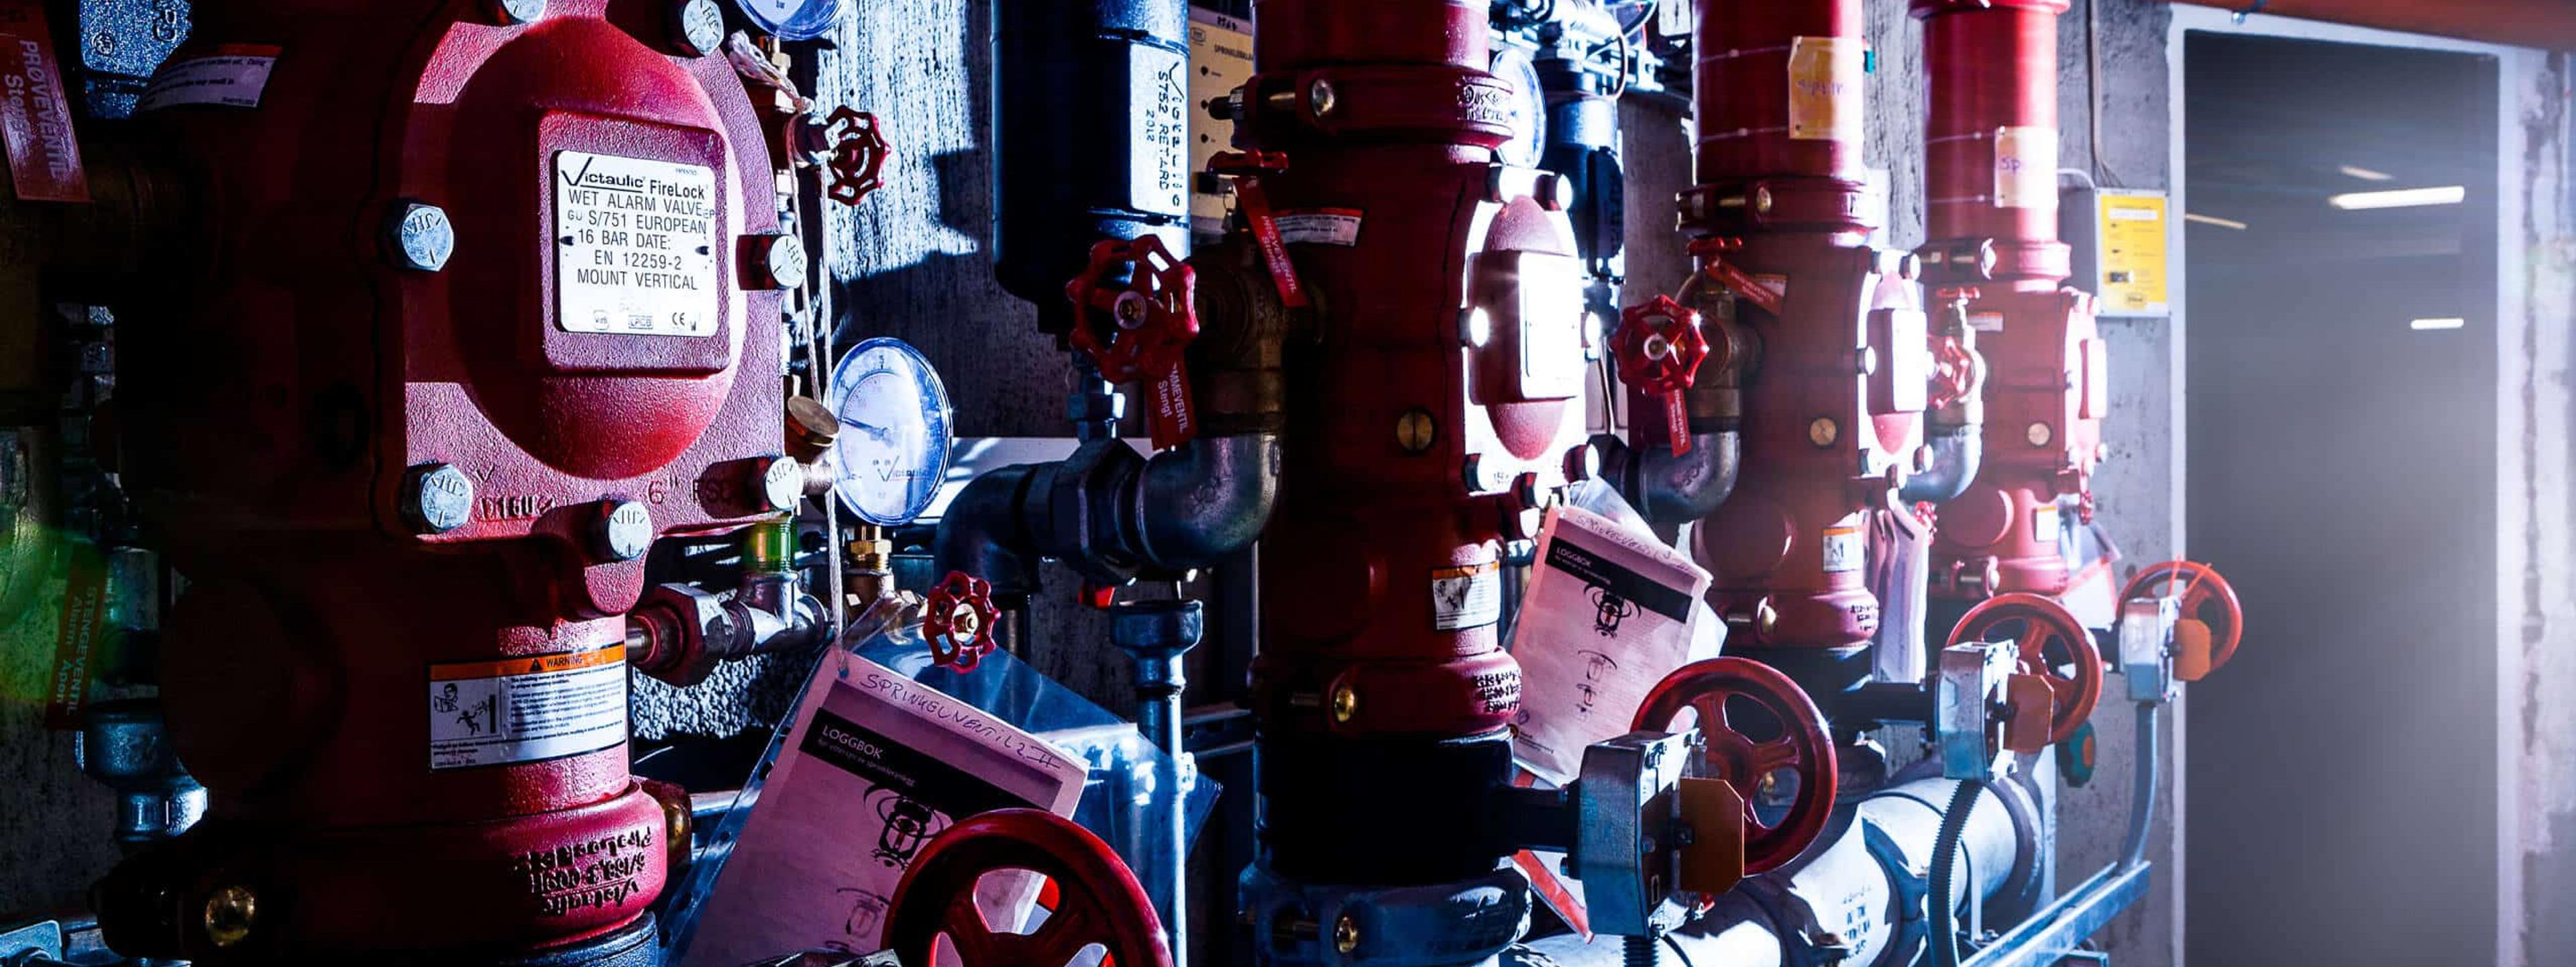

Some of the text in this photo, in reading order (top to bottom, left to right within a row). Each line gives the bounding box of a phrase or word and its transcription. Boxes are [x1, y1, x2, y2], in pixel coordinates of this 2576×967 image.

[561, 156, 704, 200] Victaulic FireLock
[568, 189, 599, 206] WET
[607, 193, 656, 212] ALARM
[664, 199, 702, 216] VALVE
[589, 210, 627, 227] S/751
[637, 215, 706, 234] EUROPEAN
[578, 230, 671, 250] 16 BAR DATE:
[595, 250, 682, 270] EN 12259-2
[578, 268, 698, 290] MOUNT VERTICAL
[546, 654, 583, 667] WARNING
[822, 725, 883, 759] LOGGBOK
